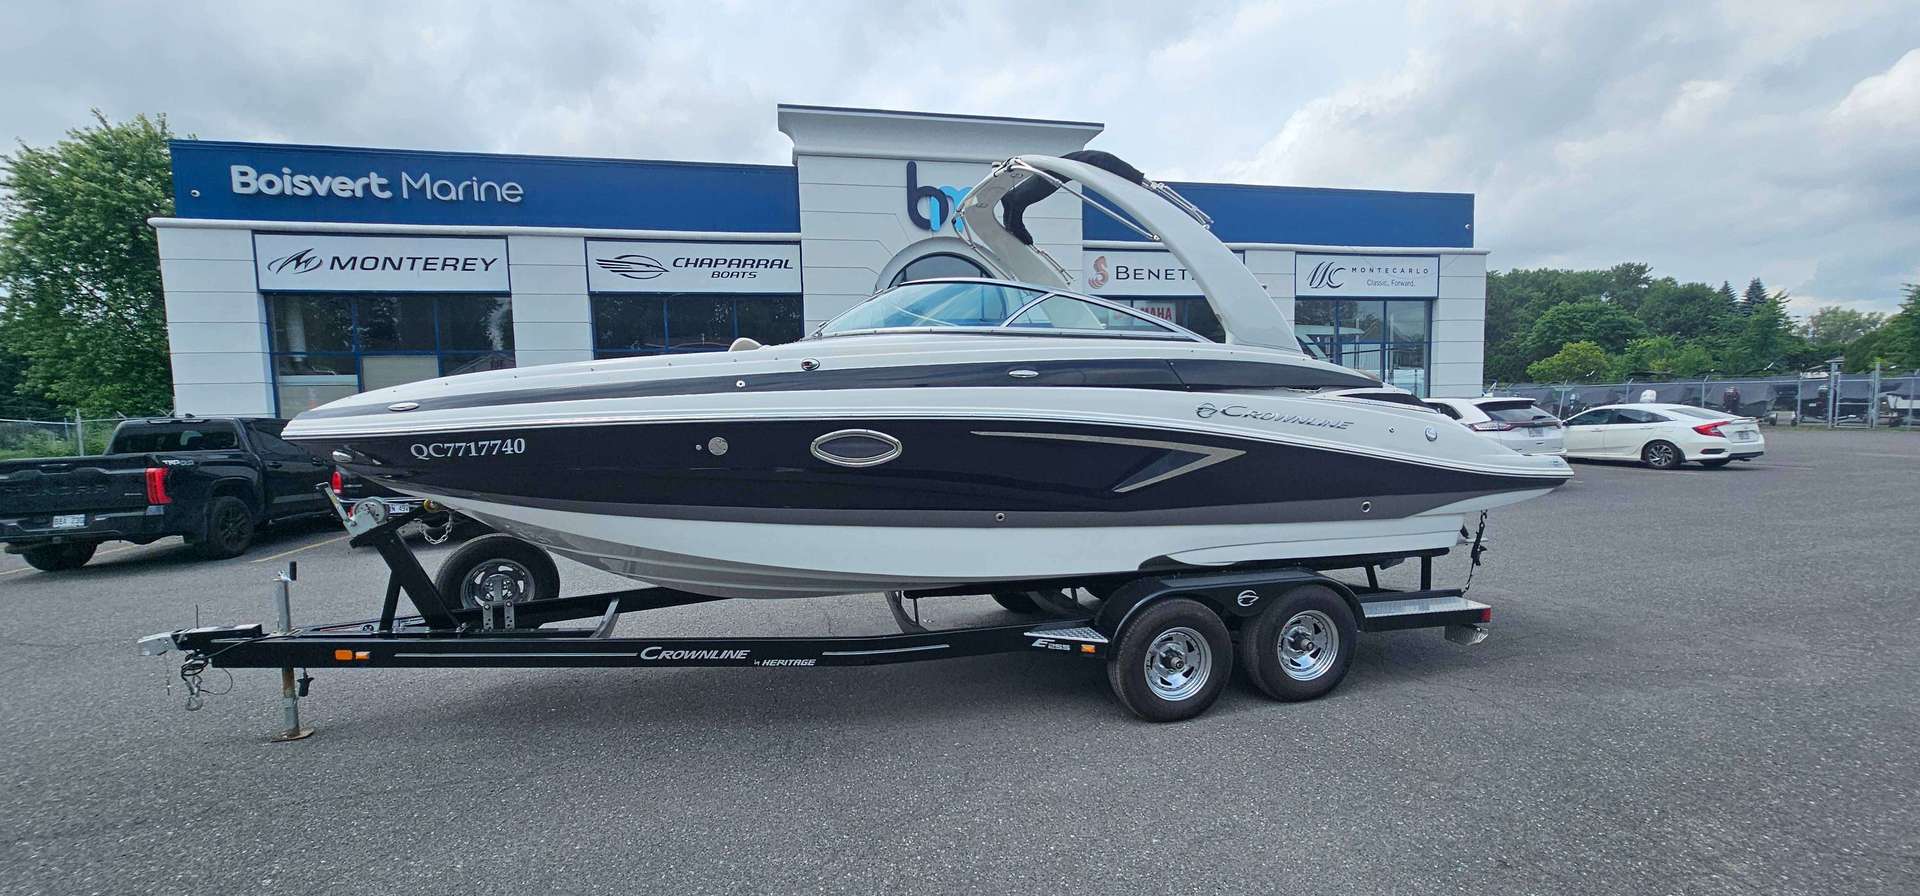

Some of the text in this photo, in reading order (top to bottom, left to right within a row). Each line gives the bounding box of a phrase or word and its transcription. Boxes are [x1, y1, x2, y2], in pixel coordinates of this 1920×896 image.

[230, 164, 524, 203] Boisvert Marine
[329, 256, 498, 272] MONTEREY
[672, 257, 793, 269] CHAPARRAL
[711, 271, 758, 279] BOATS
[1115, 265, 1194, 280] BENET
[1220, 405, 1354, 430] CROWNLINE
[410, 438, 526, 460] QC7717740
[640, 646, 750, 660] CROWNLINE
